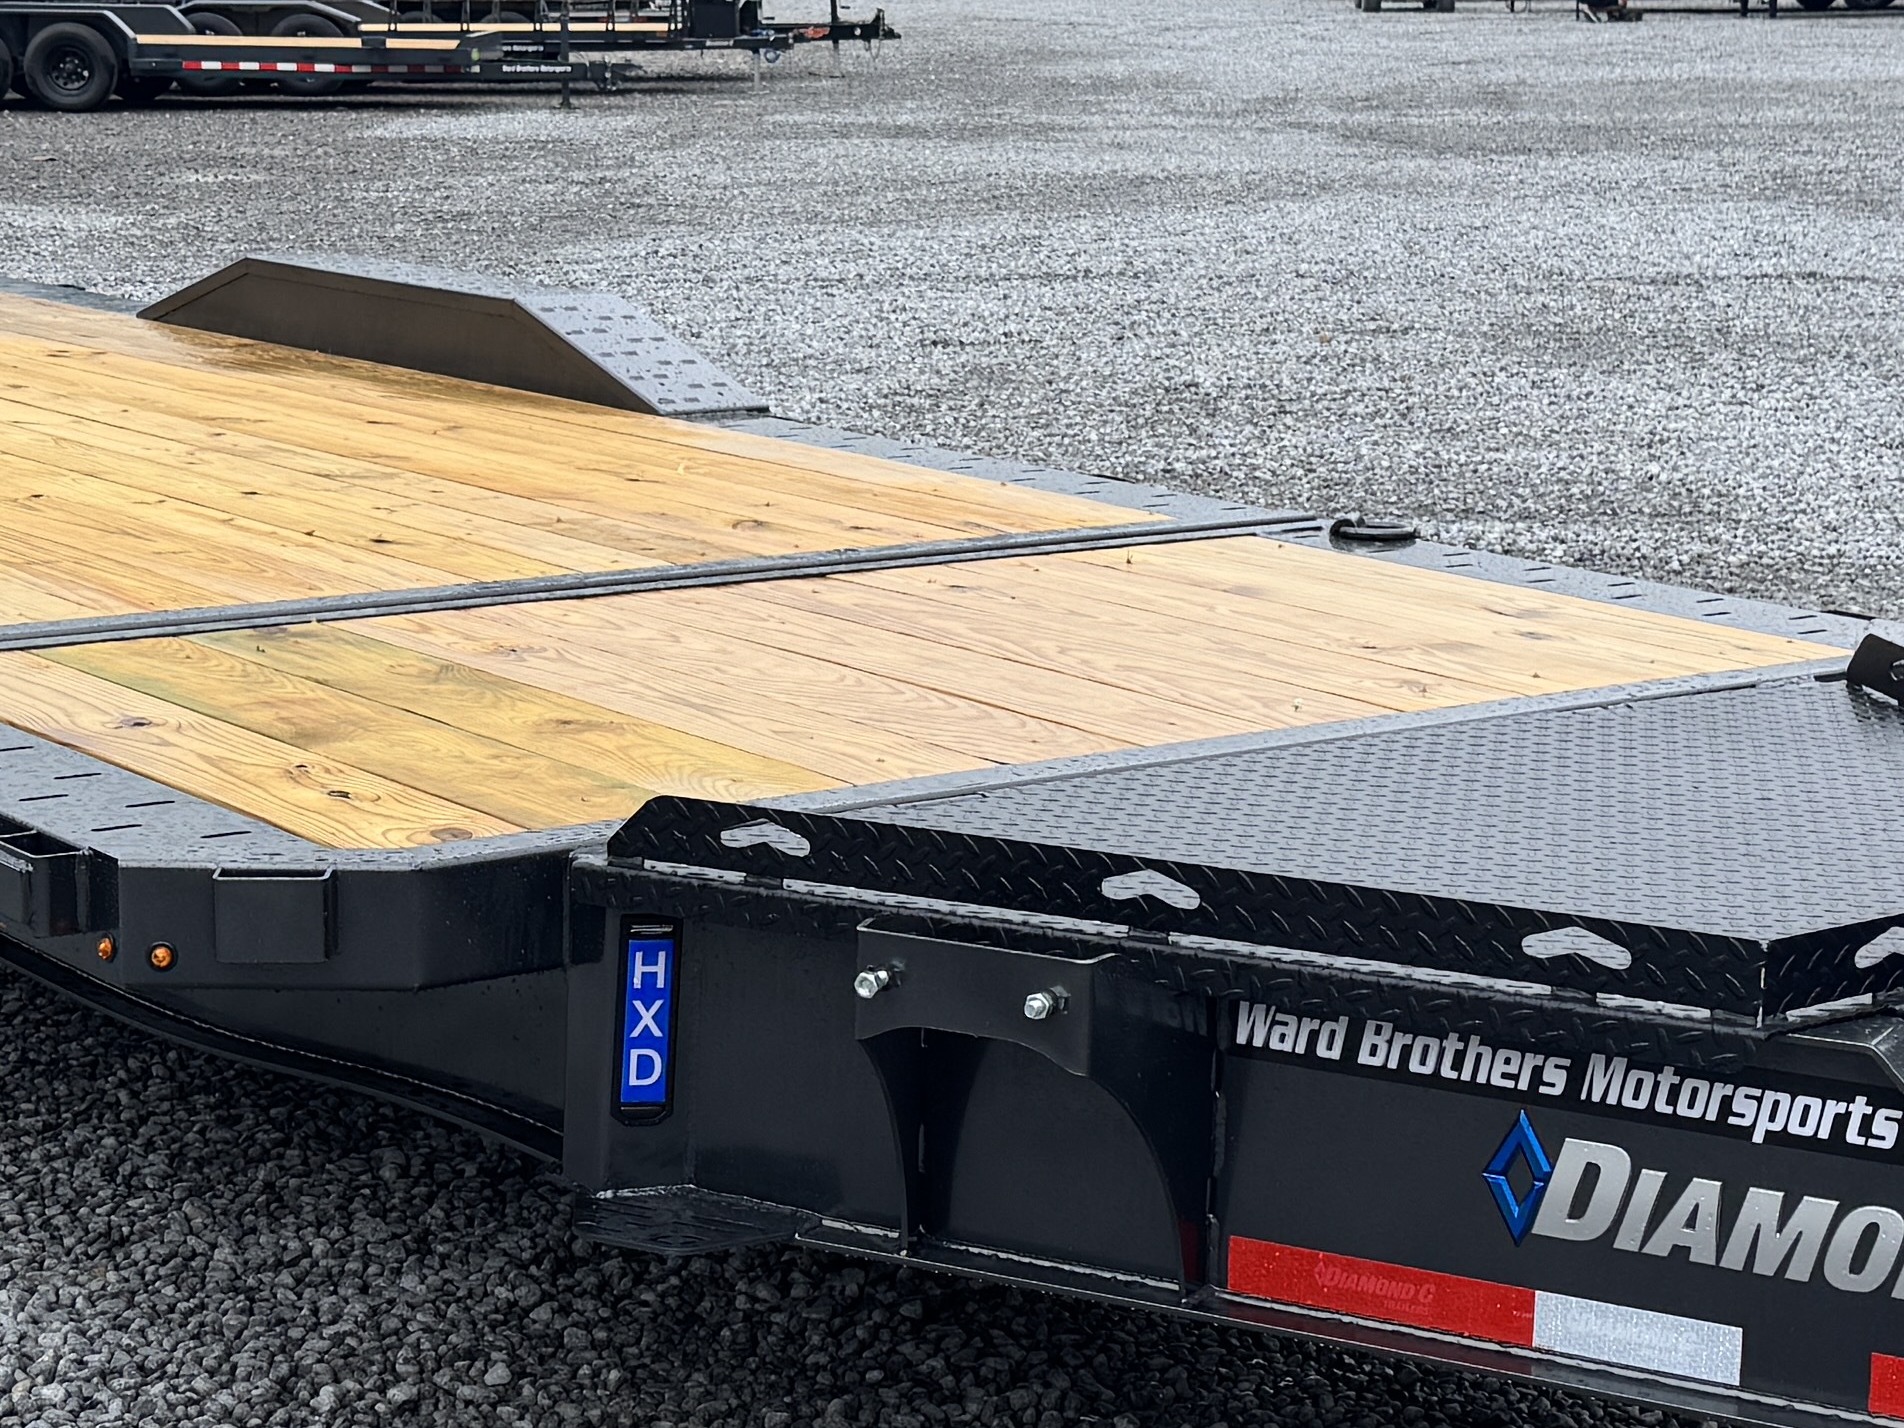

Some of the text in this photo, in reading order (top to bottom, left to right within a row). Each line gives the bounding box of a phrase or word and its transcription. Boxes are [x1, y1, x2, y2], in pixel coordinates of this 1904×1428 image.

[628, 950, 666, 1086] HXD
[1236, 1000, 1904, 1151] Ward Brothers Motorsports
[1326, 1266, 1417, 1300] DIAMOND
